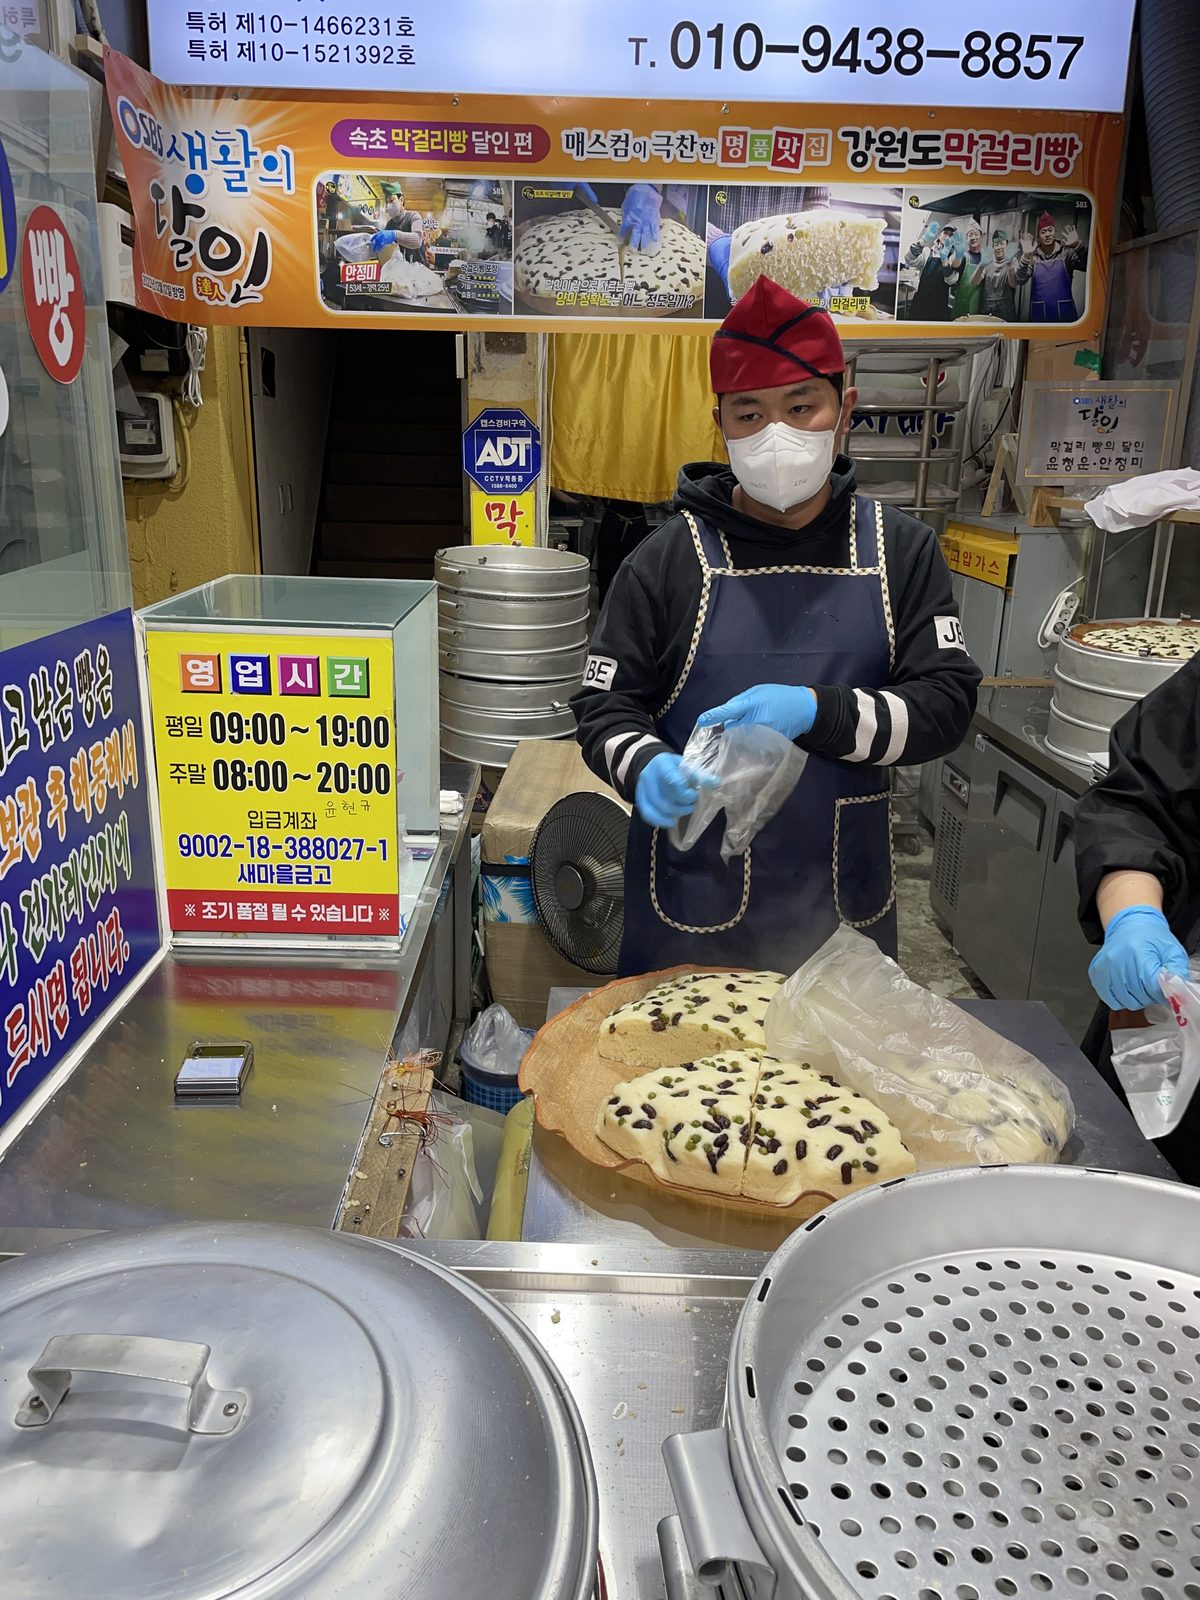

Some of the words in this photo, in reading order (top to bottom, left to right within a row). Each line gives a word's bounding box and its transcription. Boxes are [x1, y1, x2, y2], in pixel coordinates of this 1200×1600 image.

[186, 12, 226, 34] 특허
[236, 12, 416, 37] 제10-1466231호
[187, 40, 228, 62] 특허
[237, 40, 416, 65] 제10-1521392호
[627, 37, 656, 68] T.
[670, 20, 1085, 80] 010-9438-8857
[138, 113, 163, 158] SBS
[348, 127, 388, 151] 속초
[391, 128, 468, 154] 막걸리빵
[472, 130, 510, 155] 달인
[514, 131, 533, 156] 편
[564, 131, 647, 160] 매스컴이
[652, 132, 716, 160] 극찬한
[165, 128, 292, 195] 생활의
[149, 182, 269, 304] 달인
[345, 264, 377, 281] 안정미
[29, 228, 74, 366] 빵
[196, 274, 226, 301] 達人
[556, 292, 577, 306] 양의
[622, 293, 642, 307] 어느
[646, 293, 696, 308] 정도일까?
[832, 298, 868, 311] 막걸리빵
[1078, 407, 1119, 434] 달인
[475, 436, 531, 467] ADT
[1050, 441, 1086, 454] 막걸리
[1121, 441, 1145, 453] 달인
[184, 656, 365, 692] 영업시간
[0, 686, 29, 776] 고
[30, 660, 73, 752] 남은
[74, 643, 113, 728] 빵은
[165, 715, 203, 738] 평일
[169, 762, 206, 785] 주말
[0, 777, 42, 880] 보관
[47, 766, 67, 841] 후
[70, 719, 138, 823] 해동해서
[247, 810, 317, 830] 입금계좌
[178, 833, 388, 862] 9002-18-388027-1
[20, 810, 132, 964] 전자레인지에
[238, 863, 332, 886] 새마을금고
[201, 901, 233, 920] 조기
[236, 902, 269, 921] 품절
[271, 903, 287, 921] 될
[290, 904, 306, 921] 수
[310, 903, 373, 923] 있습니다
[5, 959, 69, 1088] 드시면
